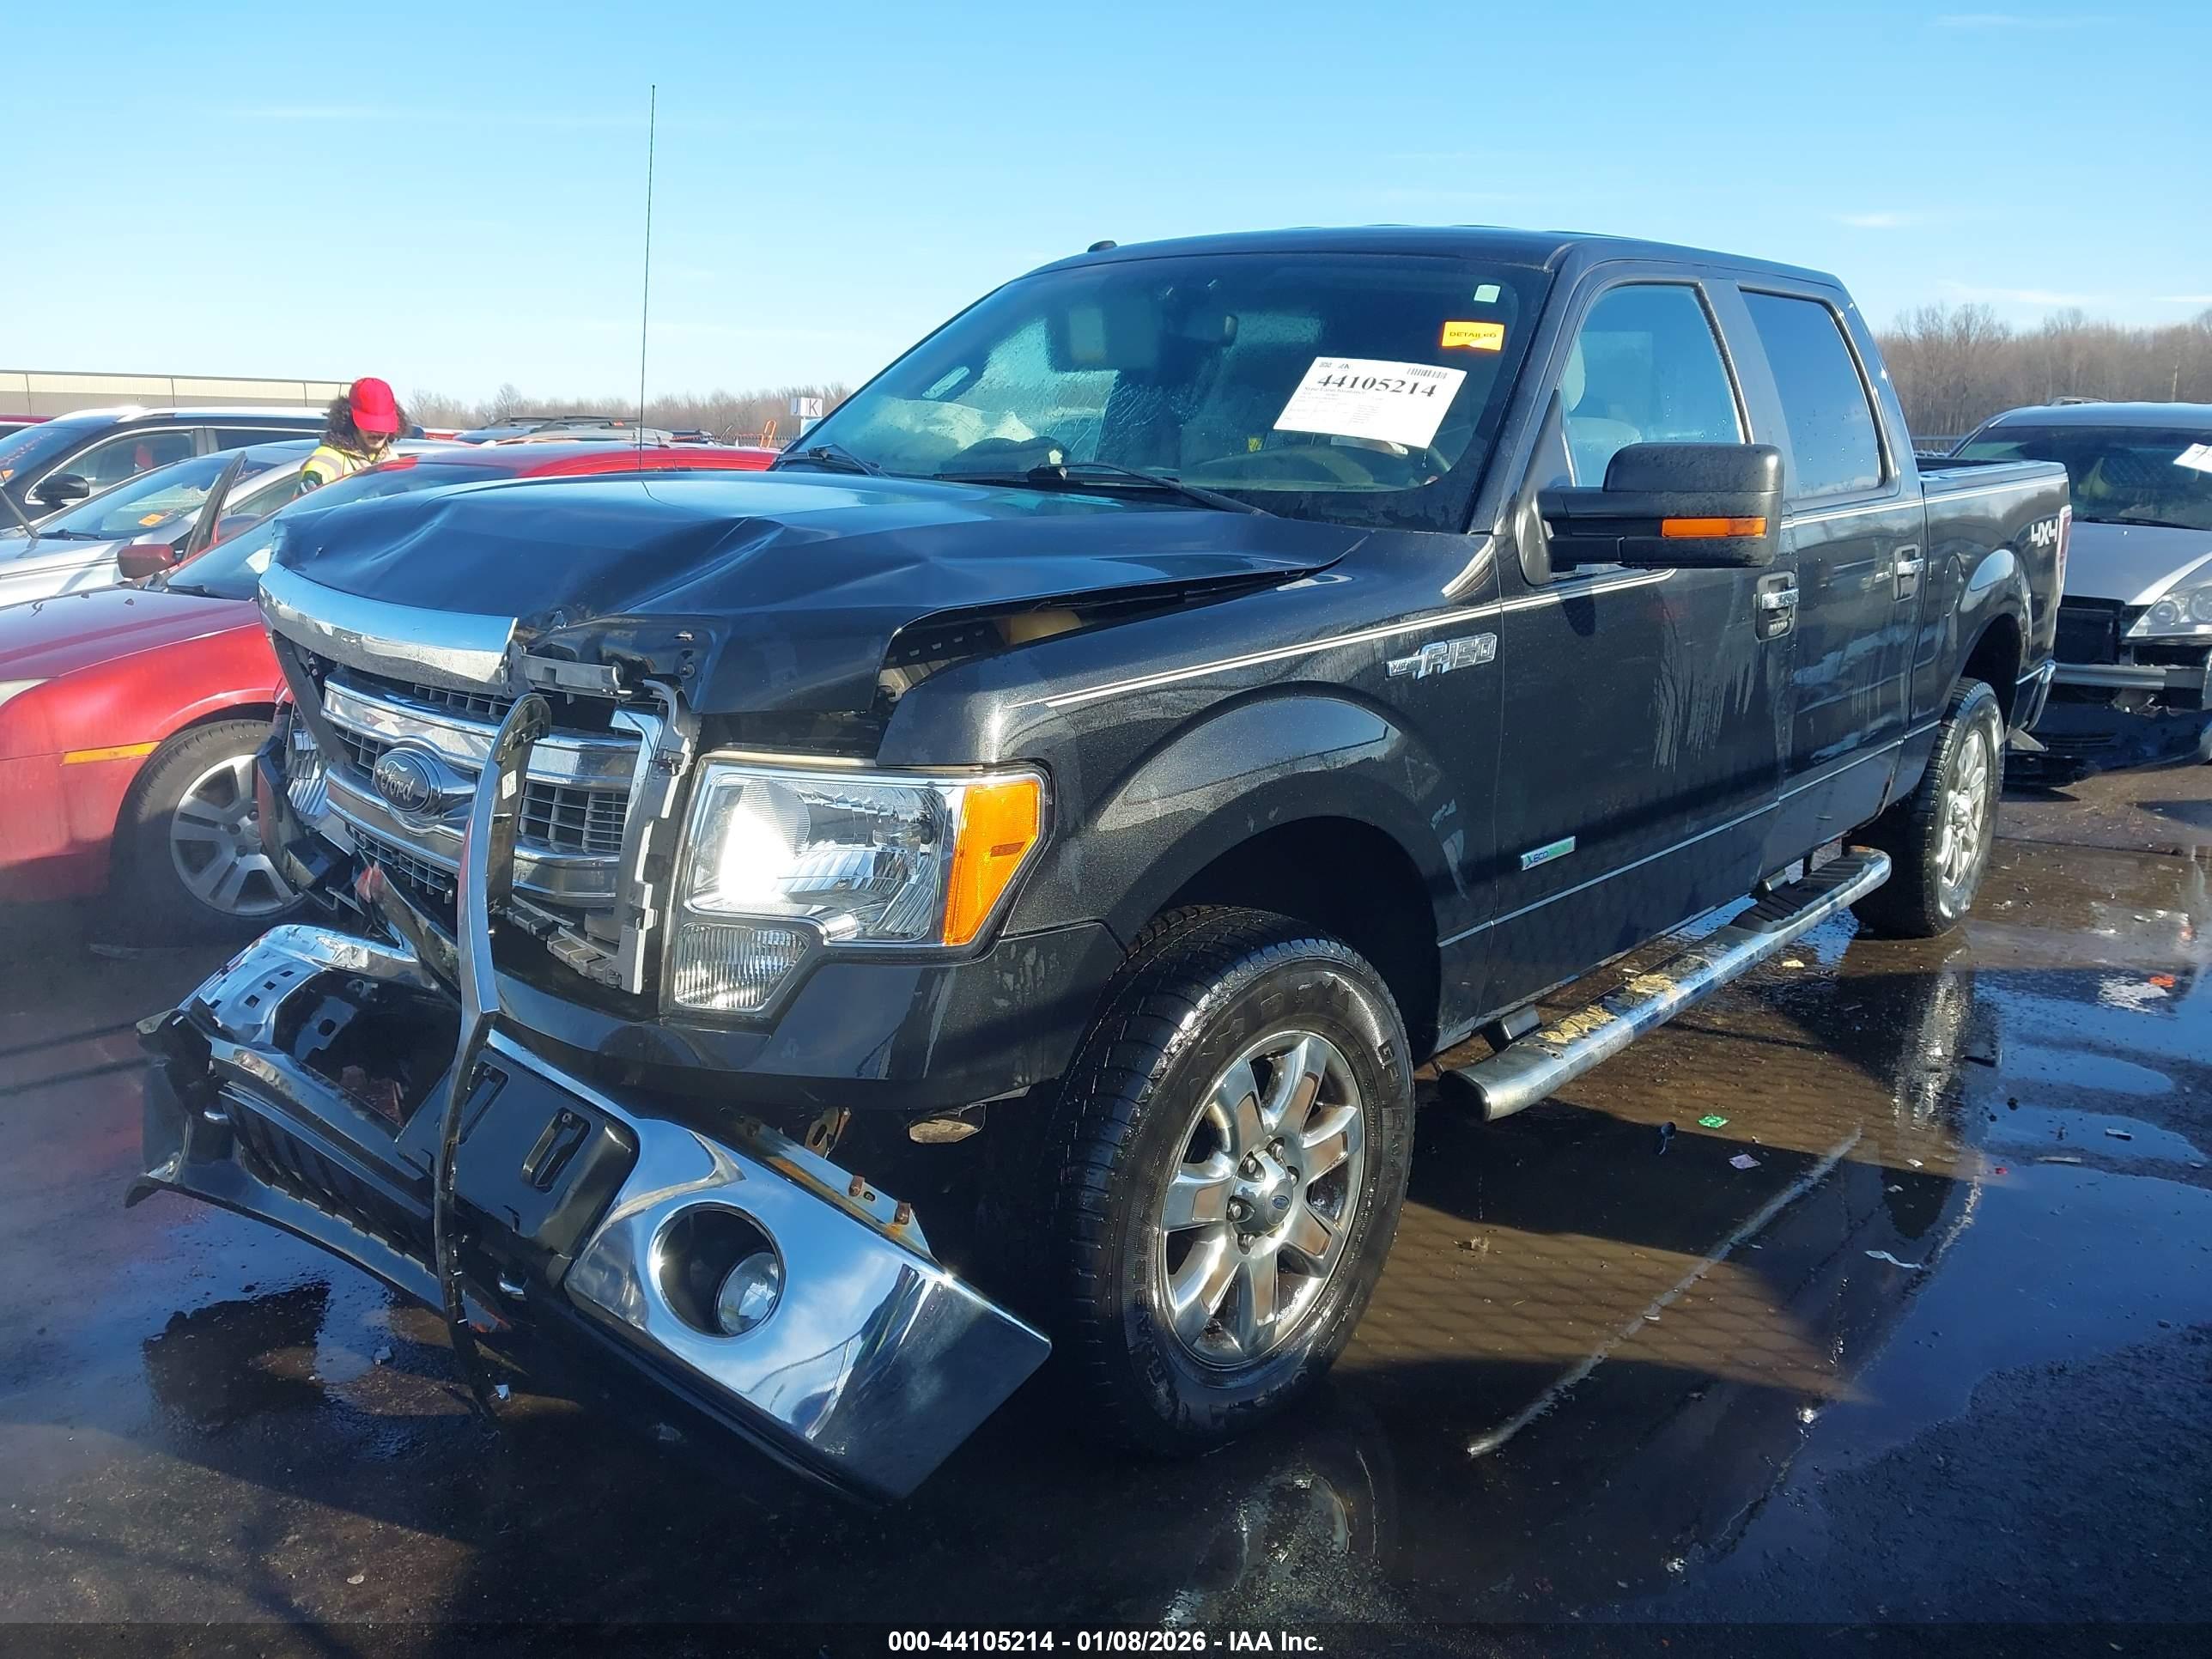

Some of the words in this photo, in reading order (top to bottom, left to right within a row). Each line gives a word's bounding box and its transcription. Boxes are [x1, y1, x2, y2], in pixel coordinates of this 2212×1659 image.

[1317, 374, 1437, 398] 44105214
[809, 398, 818, 416] K
[380, 760, 416, 802] Ford
